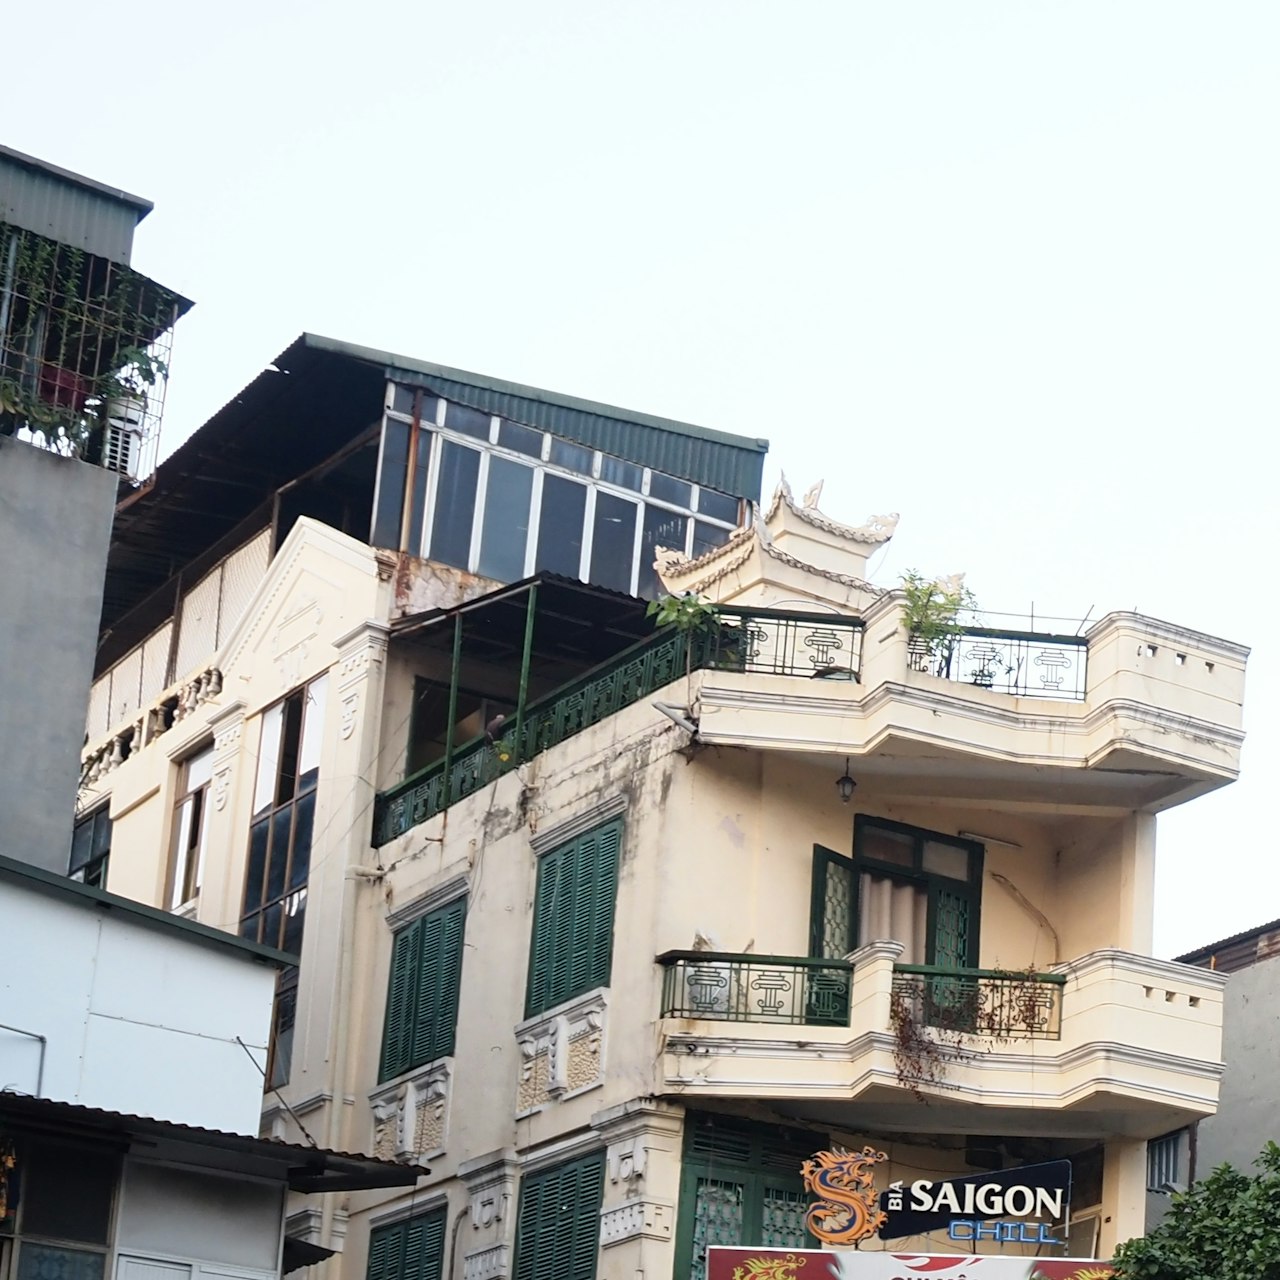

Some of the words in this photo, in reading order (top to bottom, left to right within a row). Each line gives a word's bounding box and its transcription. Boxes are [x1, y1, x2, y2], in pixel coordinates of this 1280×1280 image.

[888, 1180, 904, 1211] BIA
[910, 1179, 1064, 1219] SAIGON
[948, 1218, 1058, 1246] CHILL
